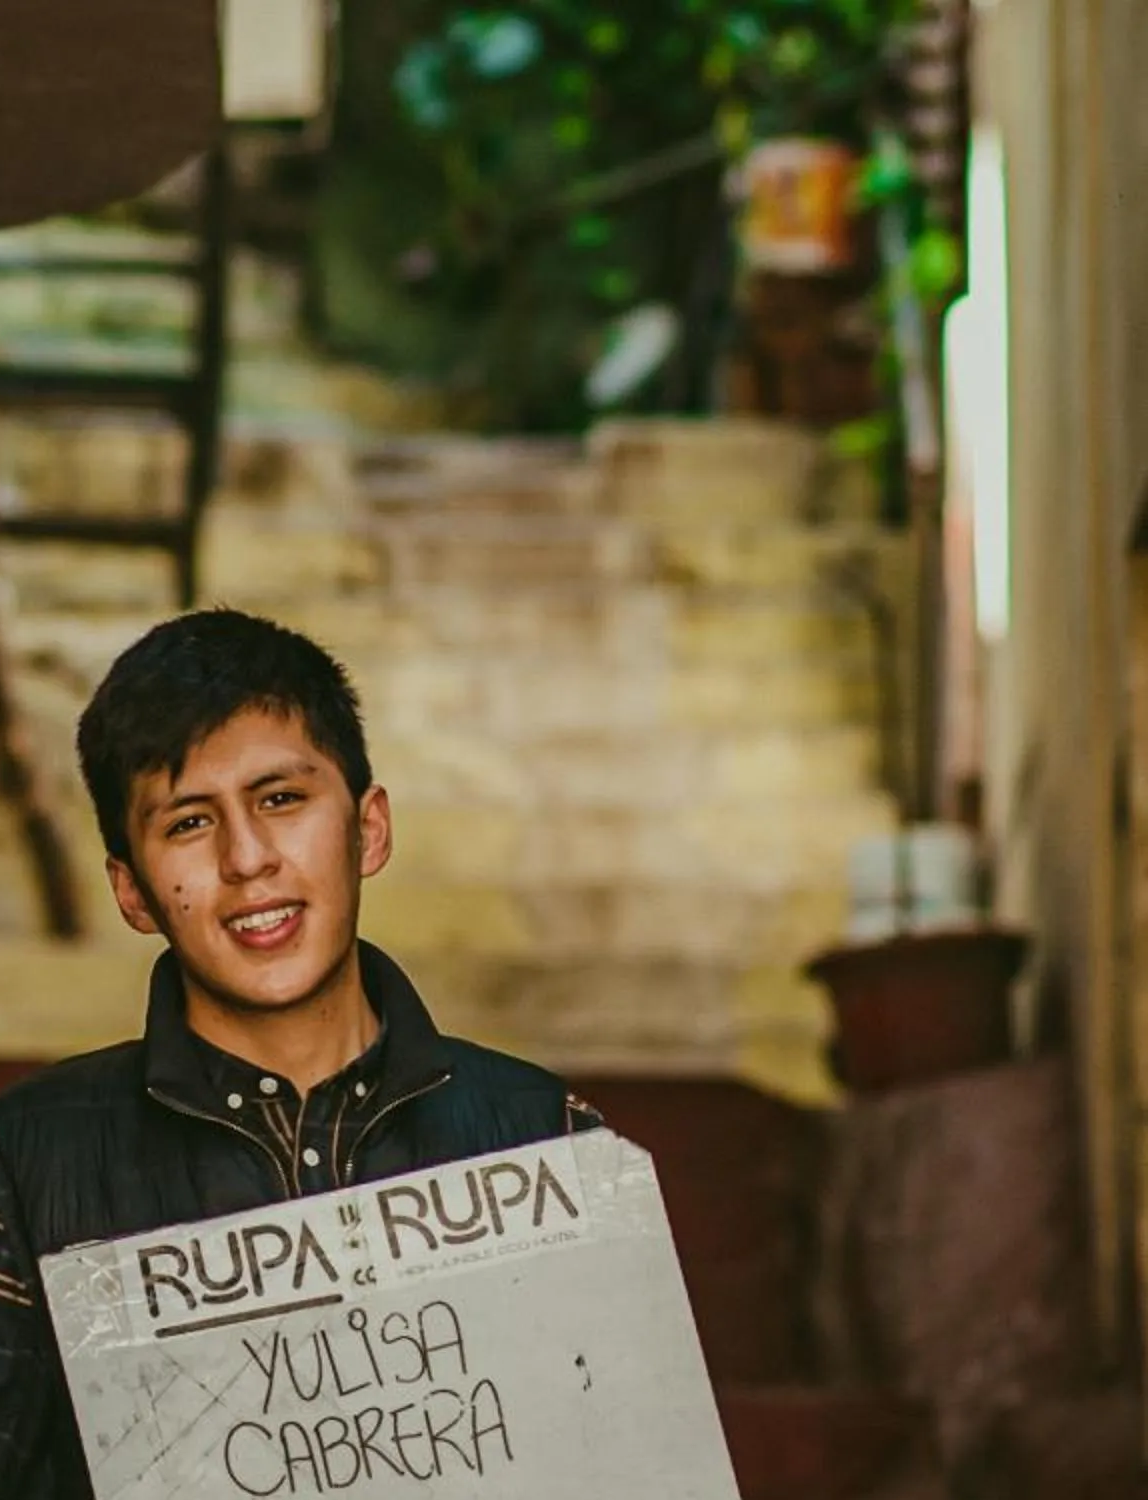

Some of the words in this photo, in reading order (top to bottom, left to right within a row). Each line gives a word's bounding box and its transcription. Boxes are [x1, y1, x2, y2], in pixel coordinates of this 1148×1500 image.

[137, 1219, 340, 1318] RUPA
[376, 1155, 580, 1260] RUPA
[224, 1378, 514, 1497] CABRERA
